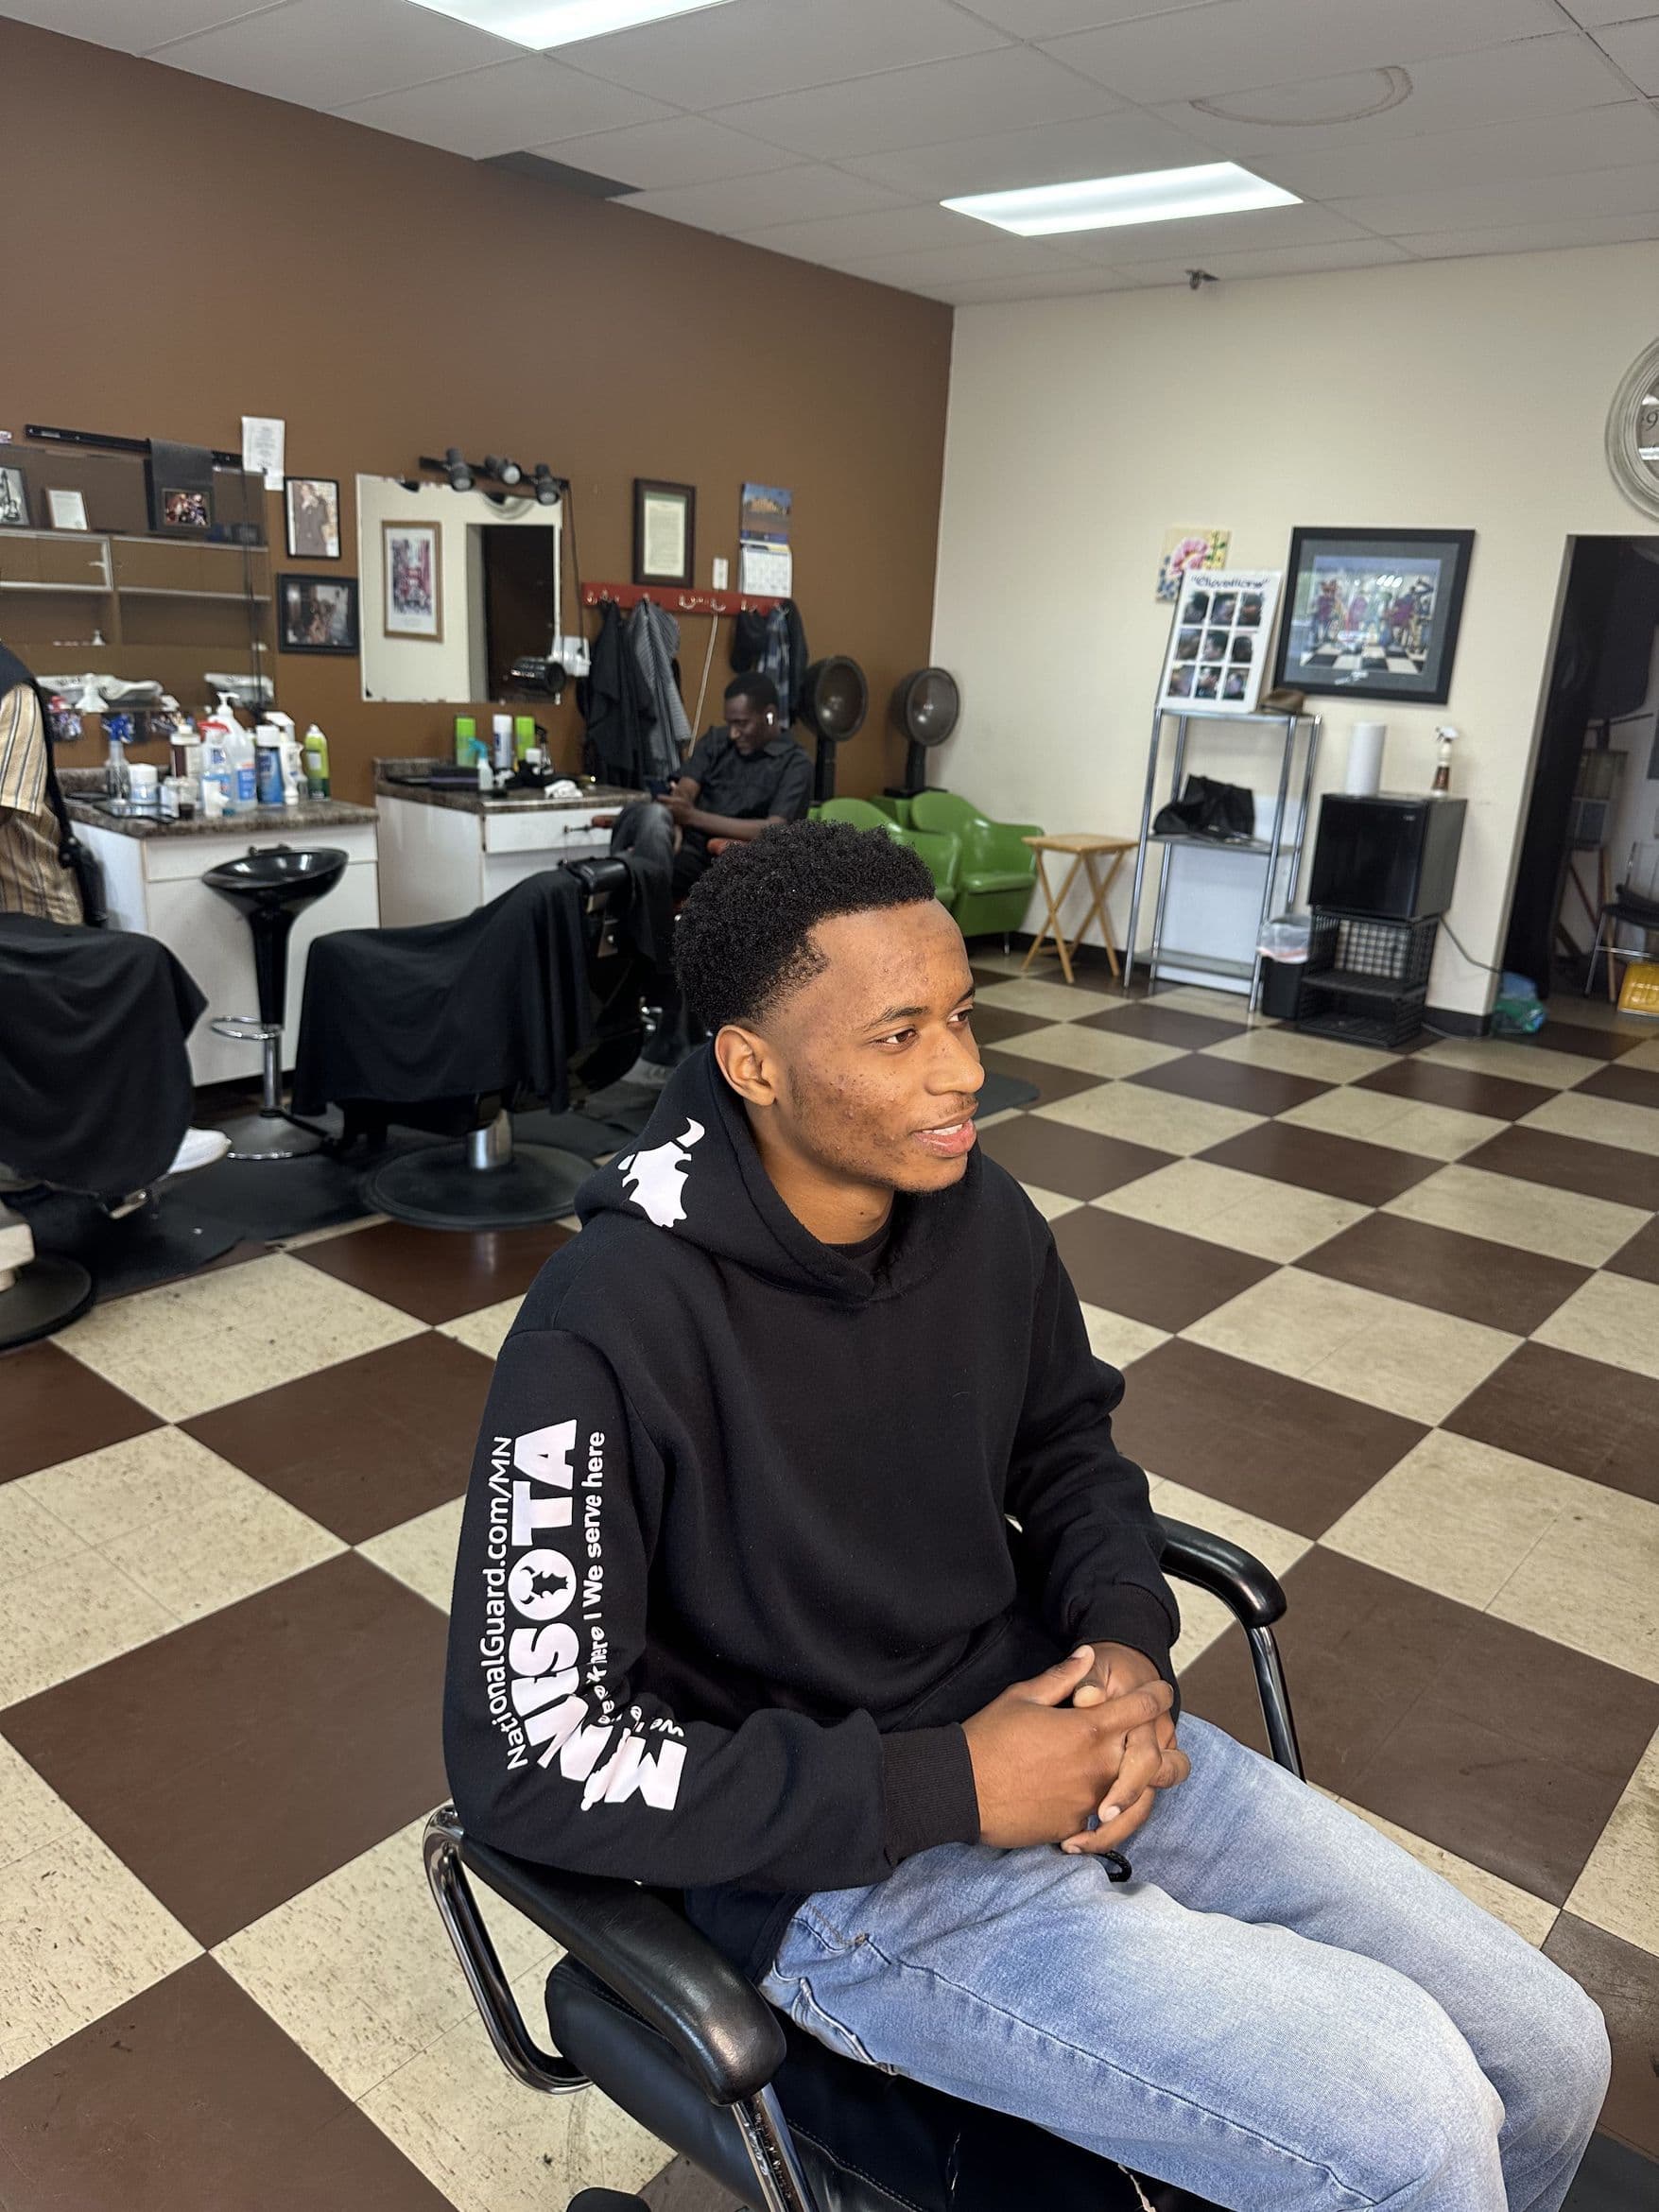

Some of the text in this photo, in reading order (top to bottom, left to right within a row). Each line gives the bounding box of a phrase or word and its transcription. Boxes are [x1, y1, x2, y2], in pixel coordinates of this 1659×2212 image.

[580, 1431, 606, 1488] here
[583, 1495, 604, 1559] serve
[480, 1436, 528, 1771] NationalGuard.com/MN
[581, 1564, 604, 1608] We
